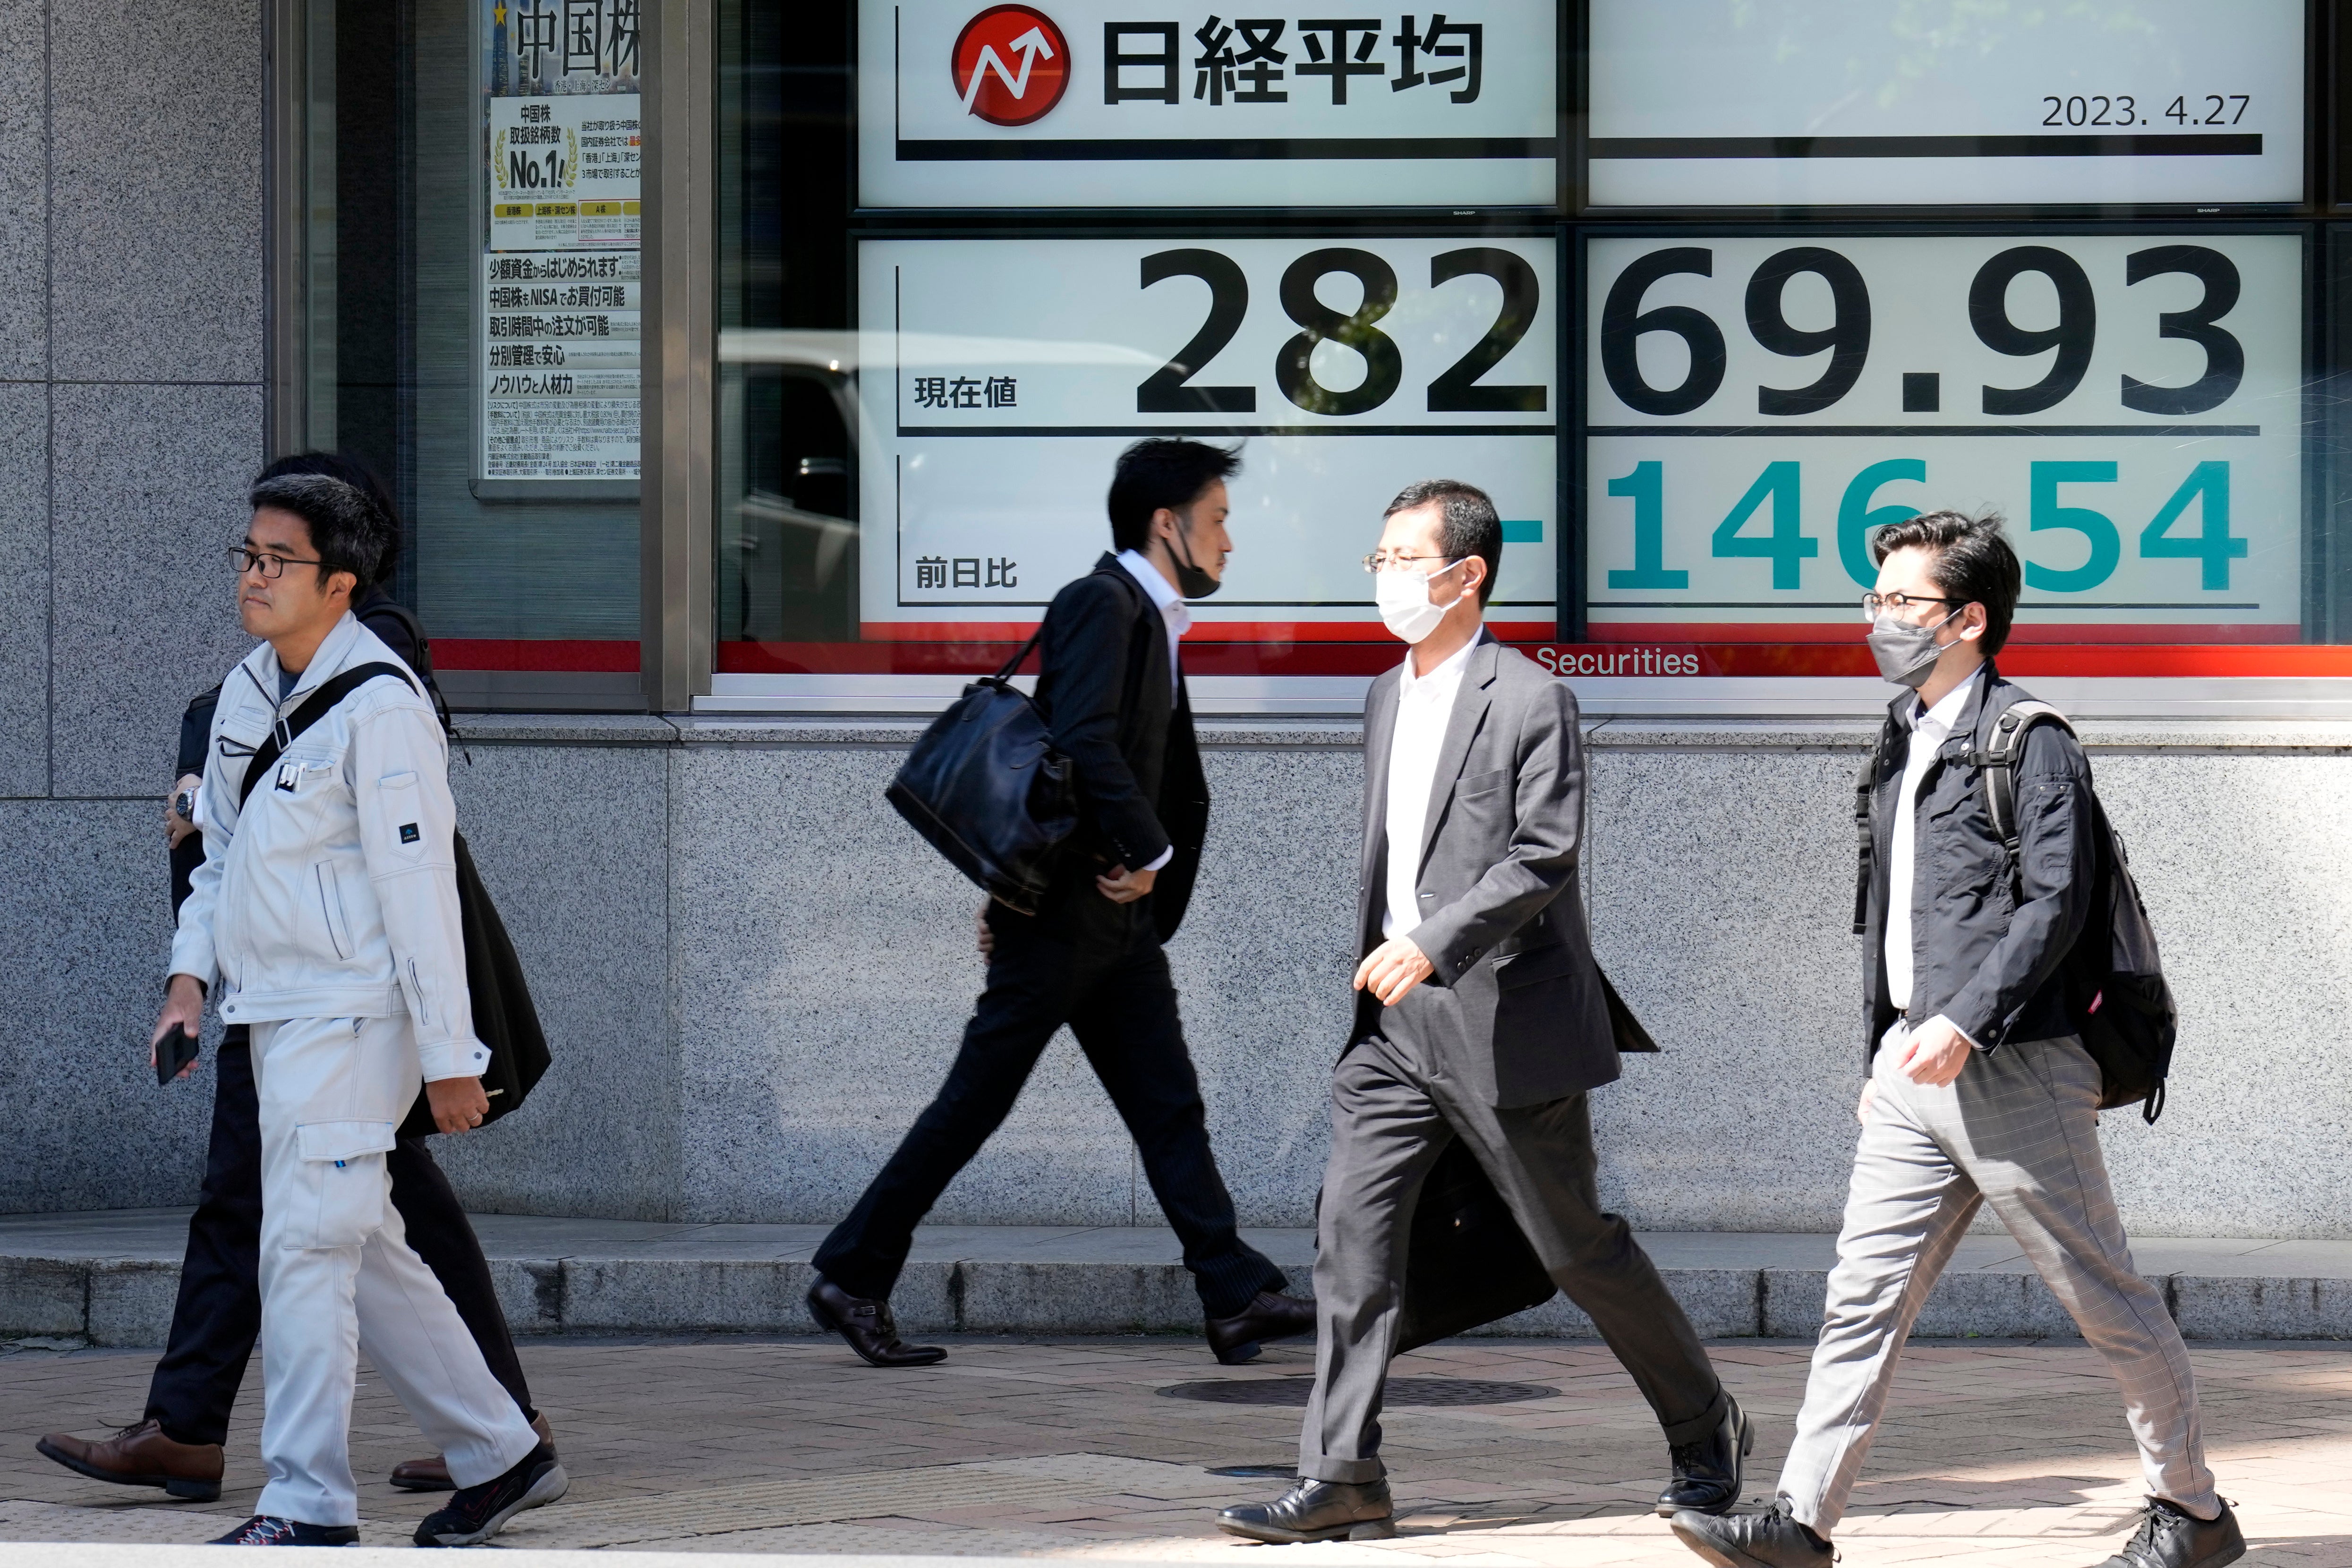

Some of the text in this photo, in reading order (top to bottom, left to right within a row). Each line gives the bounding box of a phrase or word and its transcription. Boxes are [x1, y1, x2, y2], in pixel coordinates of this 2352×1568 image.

[518, 0, 640, 78] 中国株
[1104, 14, 1483, 106] 日経平均
[521, 104, 551, 123] 中国株
[510, 126, 561, 145] 取扱銘柄数
[511, 150, 565, 188] No.1!
[489, 256, 619, 280] 少額資金からはじめられます
[490, 315, 610, 337] 取引時間中の注文が可能
[490, 344, 565, 366] 分別管理で安心
[490, 373, 573, 395] ノウハウと人材力
[914, 375, 1017, 409] 現在値
[915, 555, 1018, 589] 前日比
[1537, 648, 1699, 674] Securities
